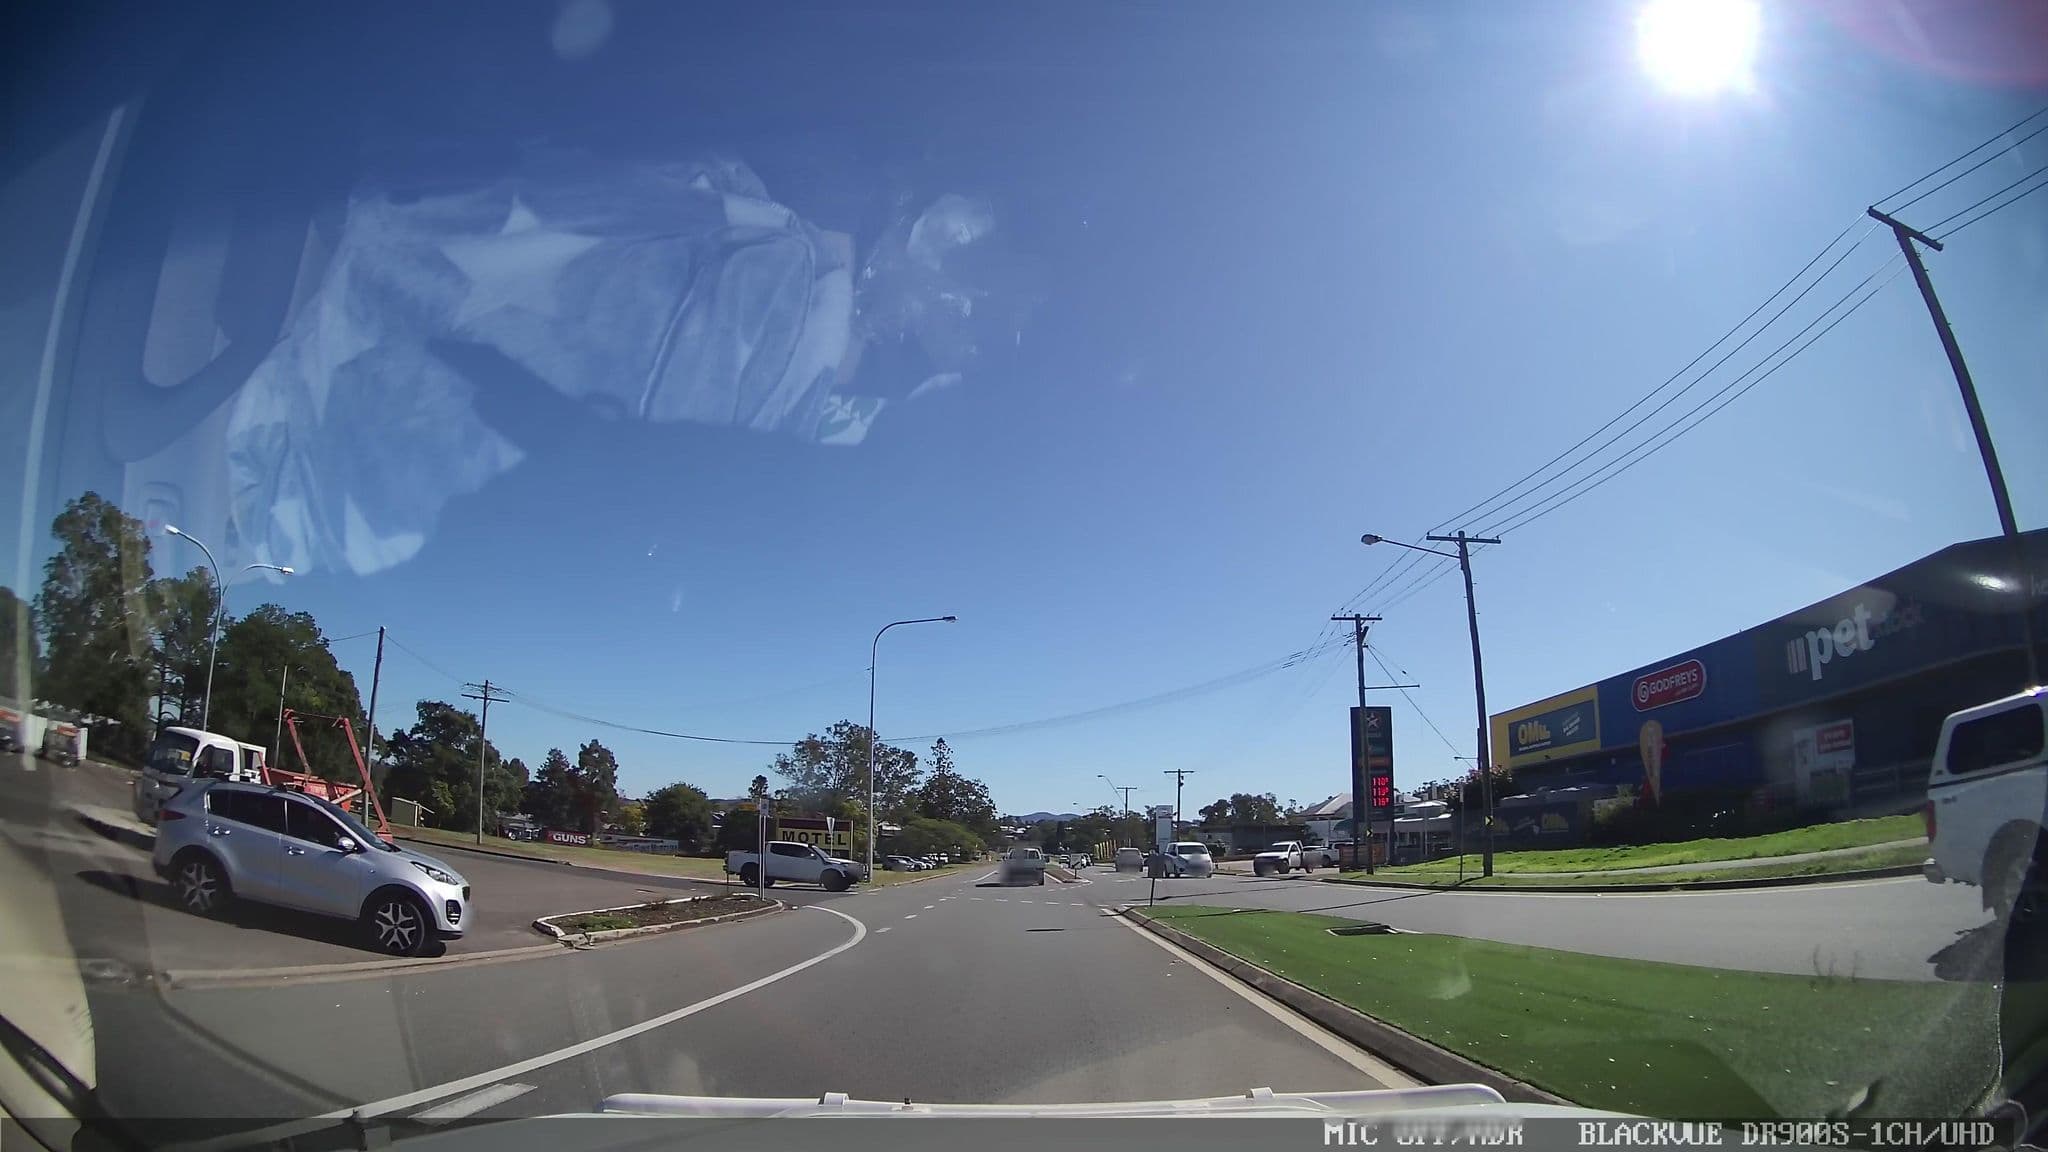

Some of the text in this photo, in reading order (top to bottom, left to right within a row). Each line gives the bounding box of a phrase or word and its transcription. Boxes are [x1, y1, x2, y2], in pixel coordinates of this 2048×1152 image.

[1649, 668, 1698, 694] GODFREYS
[552, 833, 586, 845] GUNS
[782, 830, 847, 846] MOTEL
